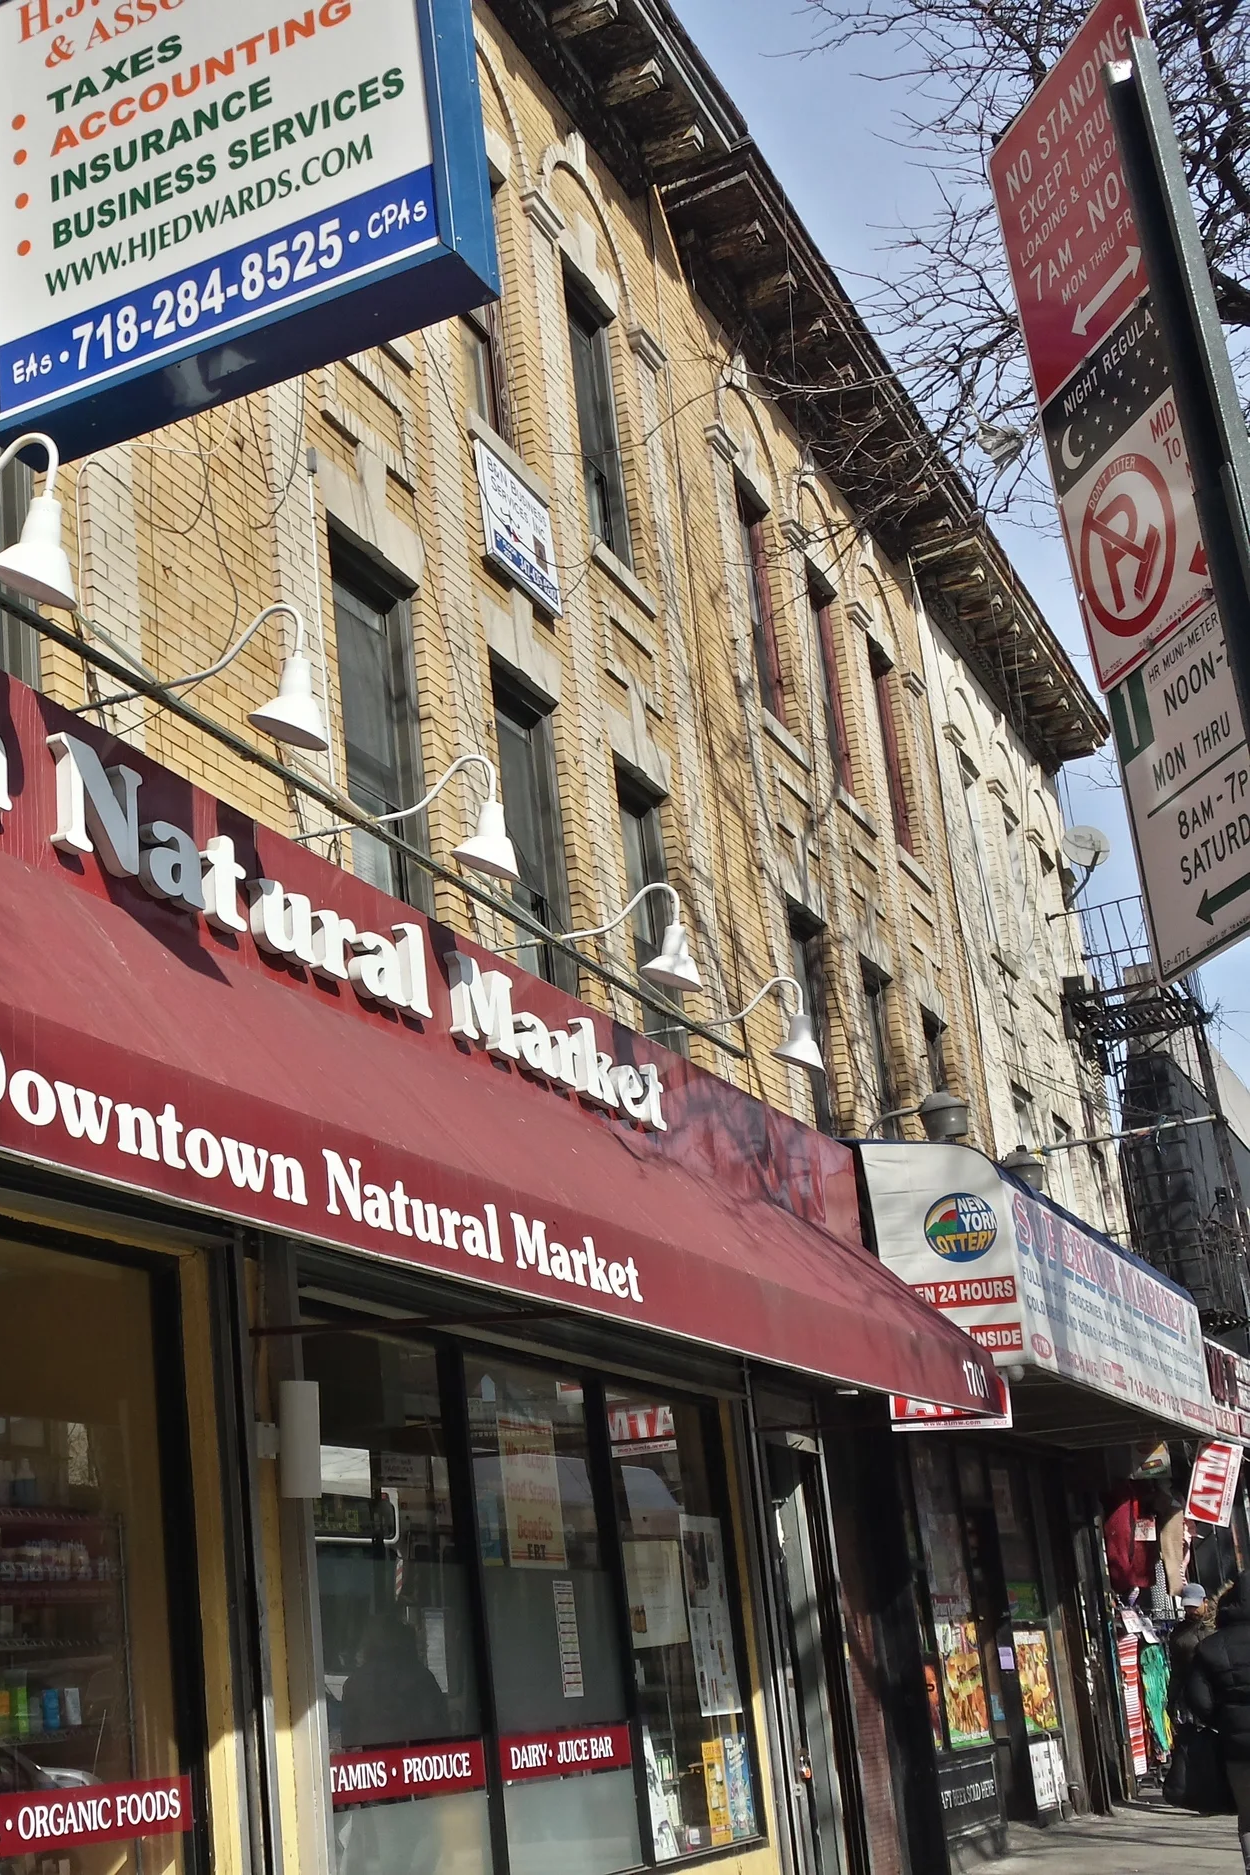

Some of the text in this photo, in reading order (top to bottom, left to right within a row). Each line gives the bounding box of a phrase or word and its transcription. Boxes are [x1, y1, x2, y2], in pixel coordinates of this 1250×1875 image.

[45, 35, 75, 68] &
[47, 35, 183, 114] TAXES
[50, 0, 352, 157] ACCOUNTING
[1006, 13, 1129, 202] NO STANDING
[50, 76, 273, 203] INSURANCE
[52, 67, 406, 250] BUSINESS SERVICES
[44, 133, 375, 297] WWW.HJEDWARDS.COM
[1018, 148, 1072, 234] EXCEPT
[1019, 202, 1068, 269] LOADING
[1071, 186, 1080, 204] &
[11, 197, 428, 385] EAs 718-284-8525 CPAs
[1060, 265, 1087, 305] MON
[1089, 232, 1115, 273] THRU
[1063, 302, 1154, 417] NIGHT REGULA
[1149, 401, 1175, 444] MID
[1163, 437, 1181, 465] TO
[1109, 456, 1136, 479] LITTER
[510, 480, 548, 527] BUSINESS
[1147, 612, 1219, 684] HR MUNI-METER
[1152, 711, 1231, 792] MON THRU
[46, 731, 433, 1020] Natural
[444, 950, 669, 1132] Market
[321, 1148, 504, 1264] Natural
[510, 1211, 644, 1303] Market
[956, 1197, 986, 1213] NEW
[960, 1212, 998, 1232] YORK
[928, 1231, 996, 1255] LOTTERY
[938, 1285, 957, 1302] 24
[960, 1280, 1014, 1301] HOURS
[1021, 1265, 1041, 1288] FULL
[1026, 1294, 1046, 1316] COLD
[962, 1360, 990, 1399] 1701
[1191, 1448, 1230, 1516] ATM
[403, 1753, 471, 1783] PRODUCE
[510, 1736, 614, 1770] DAIRY JUICE BAR
[18, 1798, 112, 1840] ORGANIC
[115, 1788, 181, 1827] FOODS
[981, 1779, 996, 1799] HERE
